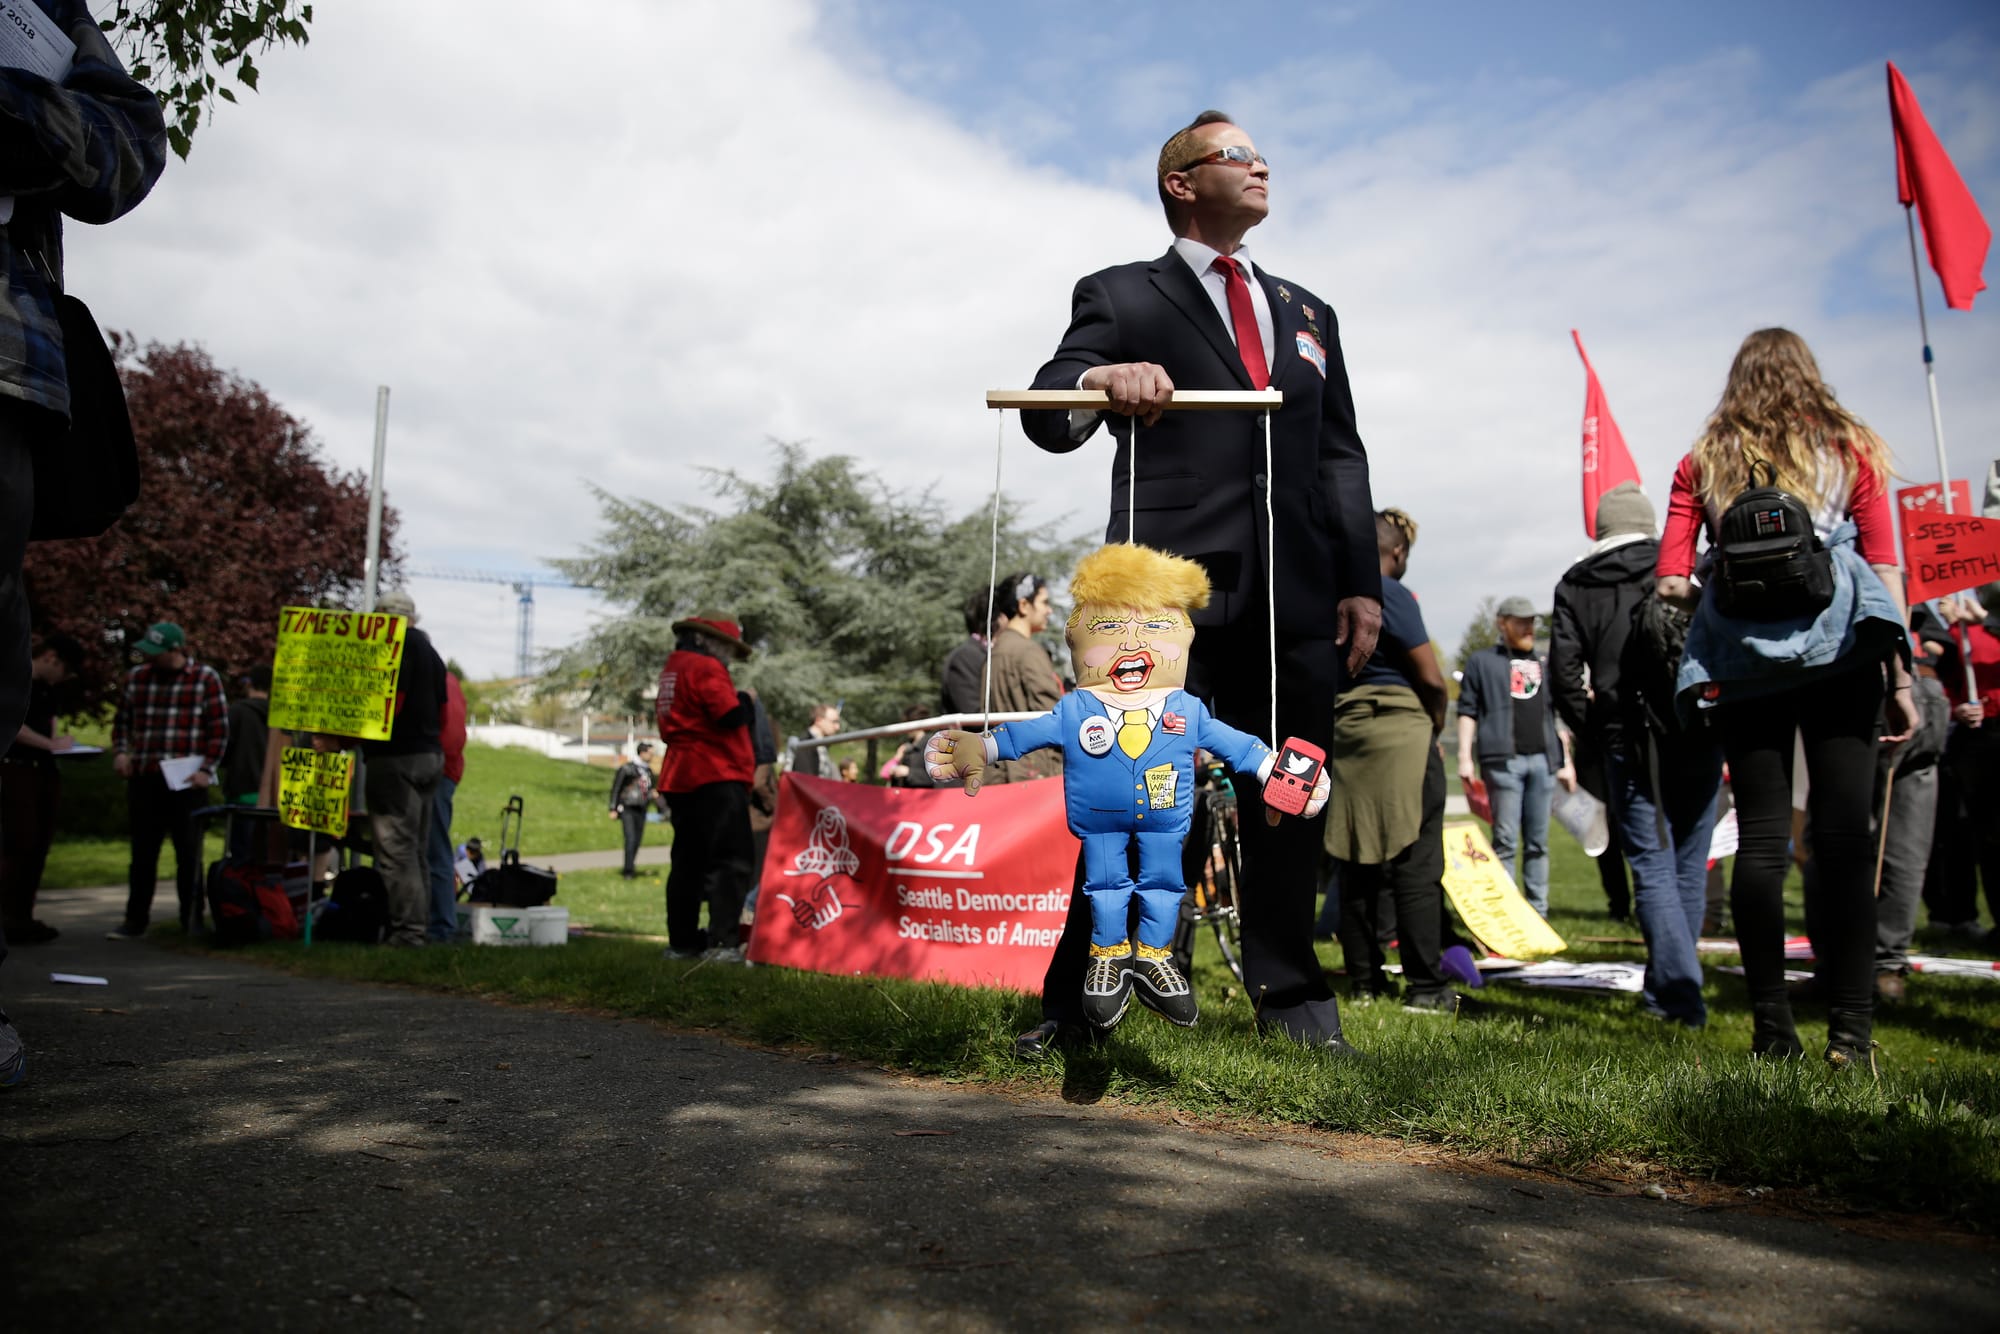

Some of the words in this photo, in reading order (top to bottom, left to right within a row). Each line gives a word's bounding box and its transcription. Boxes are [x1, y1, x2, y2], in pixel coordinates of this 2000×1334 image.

[6, 9, 35, 40] 2018
[1916, 520, 1985, 540] SESTA
[1920, 552, 2000, 583] DEATH
[283, 610, 352, 636] TIME'S
[1149, 782, 1173, 792] WALL
[885, 821, 982, 866] DSA
[897, 884, 952, 910] Seattle
[956, 888, 1071, 912] Democratic
[898, 916, 982, 944] Socialists
[986, 920, 1008, 944] of
[1009, 922, 1066, 947] Ameri
